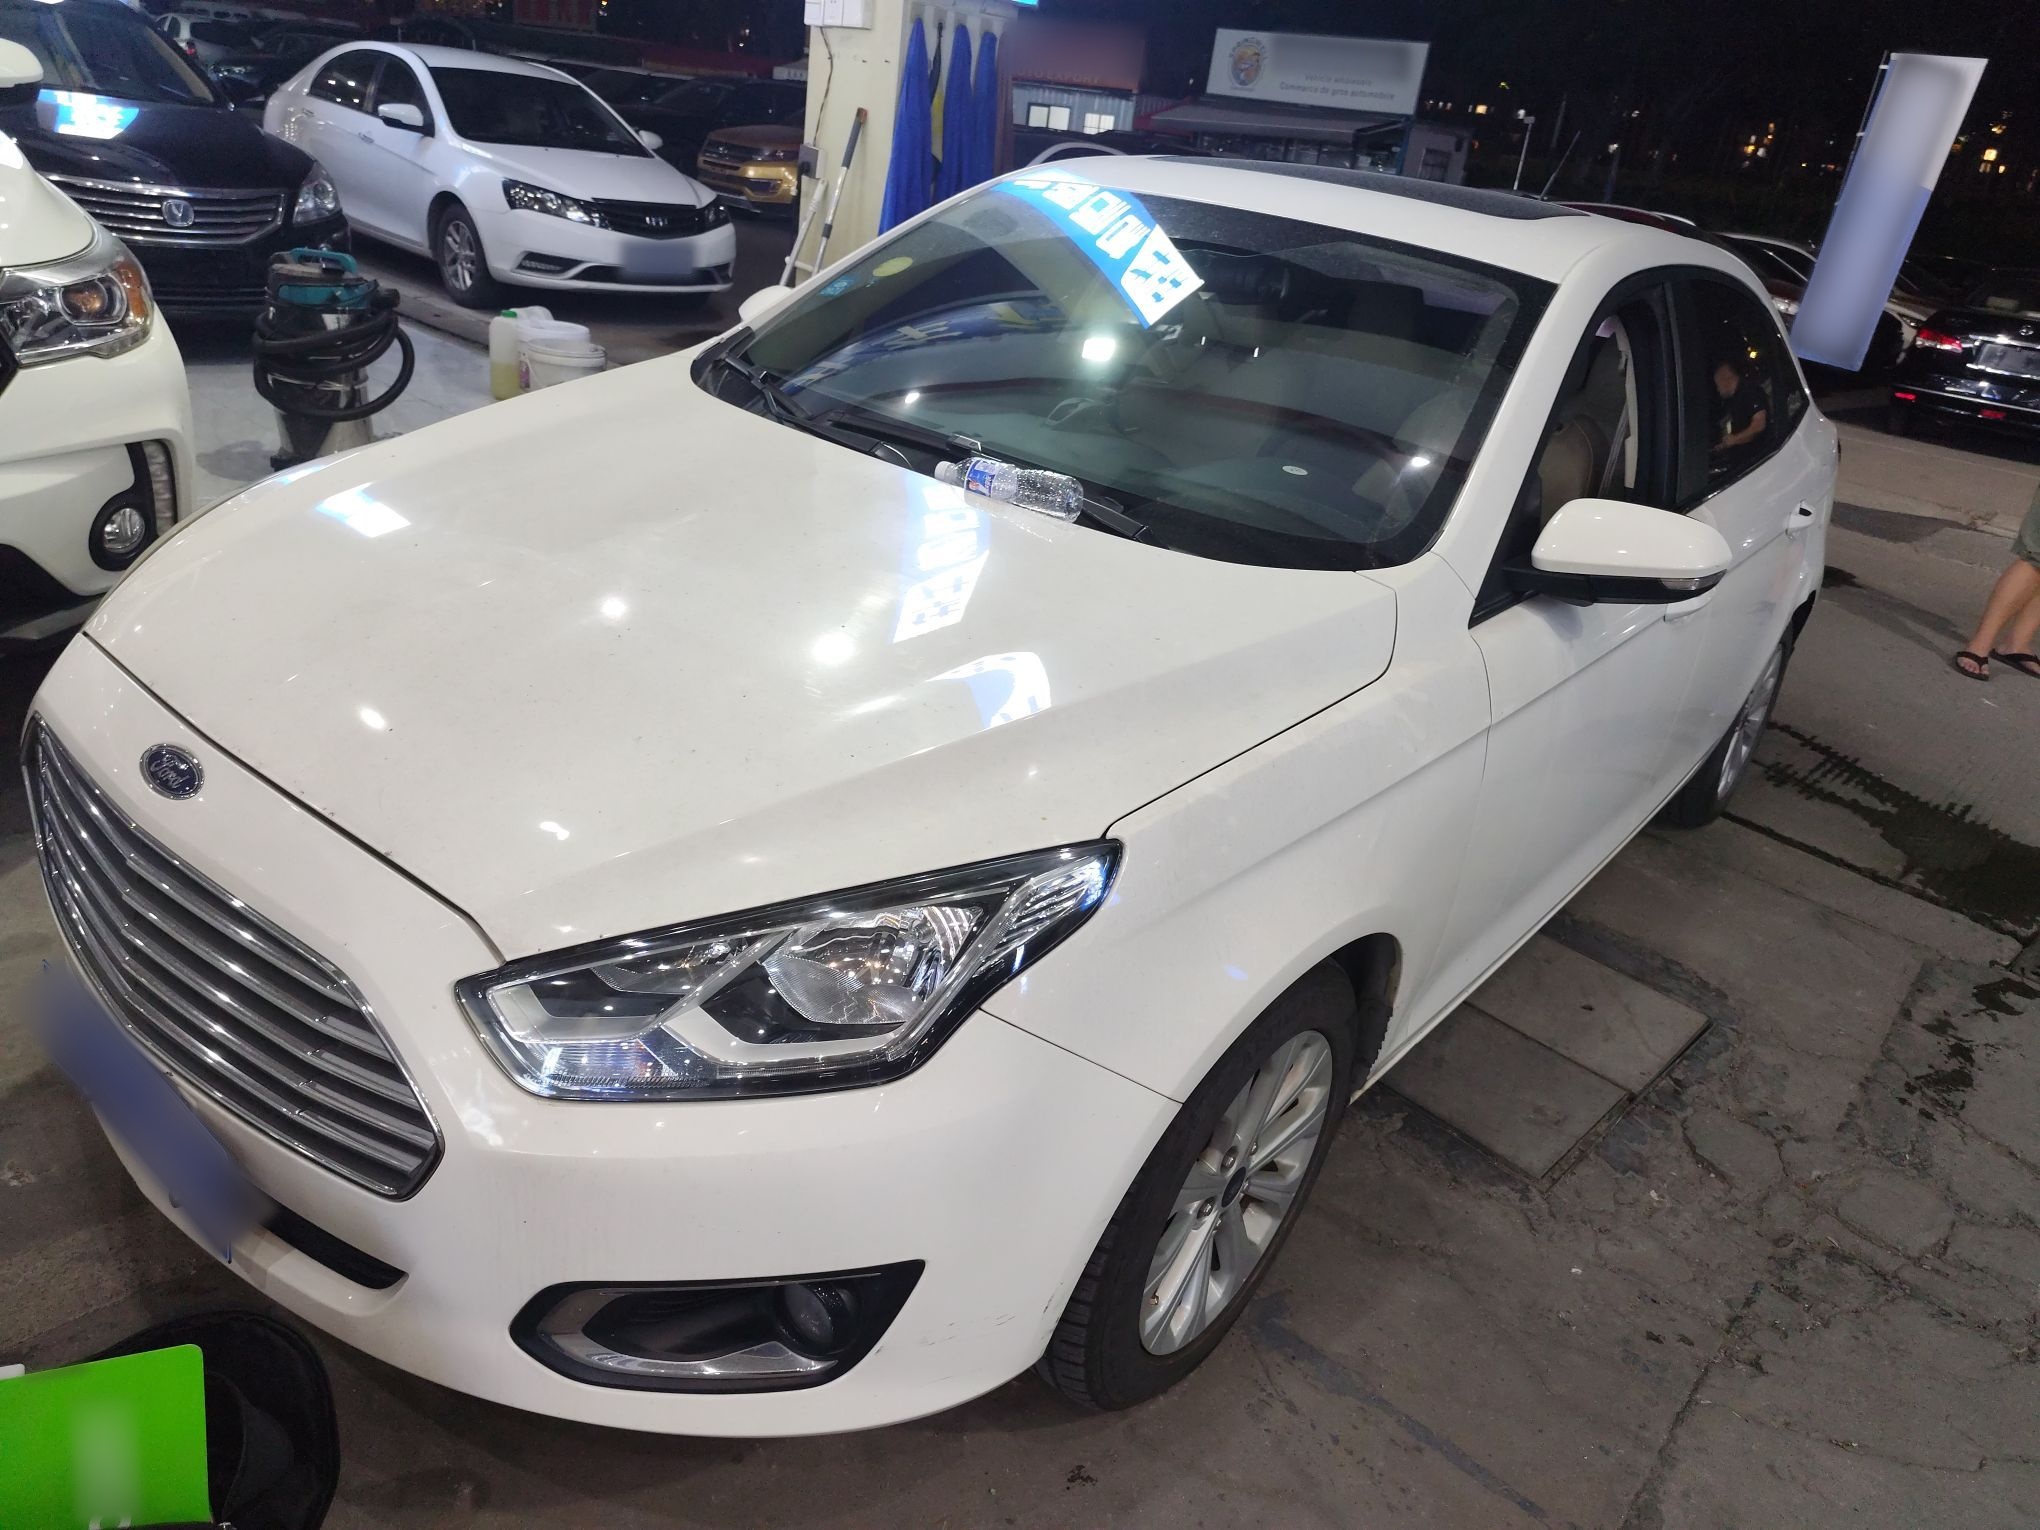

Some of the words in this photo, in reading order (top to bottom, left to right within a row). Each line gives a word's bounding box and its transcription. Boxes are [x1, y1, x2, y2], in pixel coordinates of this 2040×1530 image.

[1279, 80, 1318, 93] Commerce
[1320, 86, 1329, 94] de
[1331, 88, 1348, 97] gros
[1350, 90, 1395, 101] automobile
[150, 754, 190, 789] Ford
